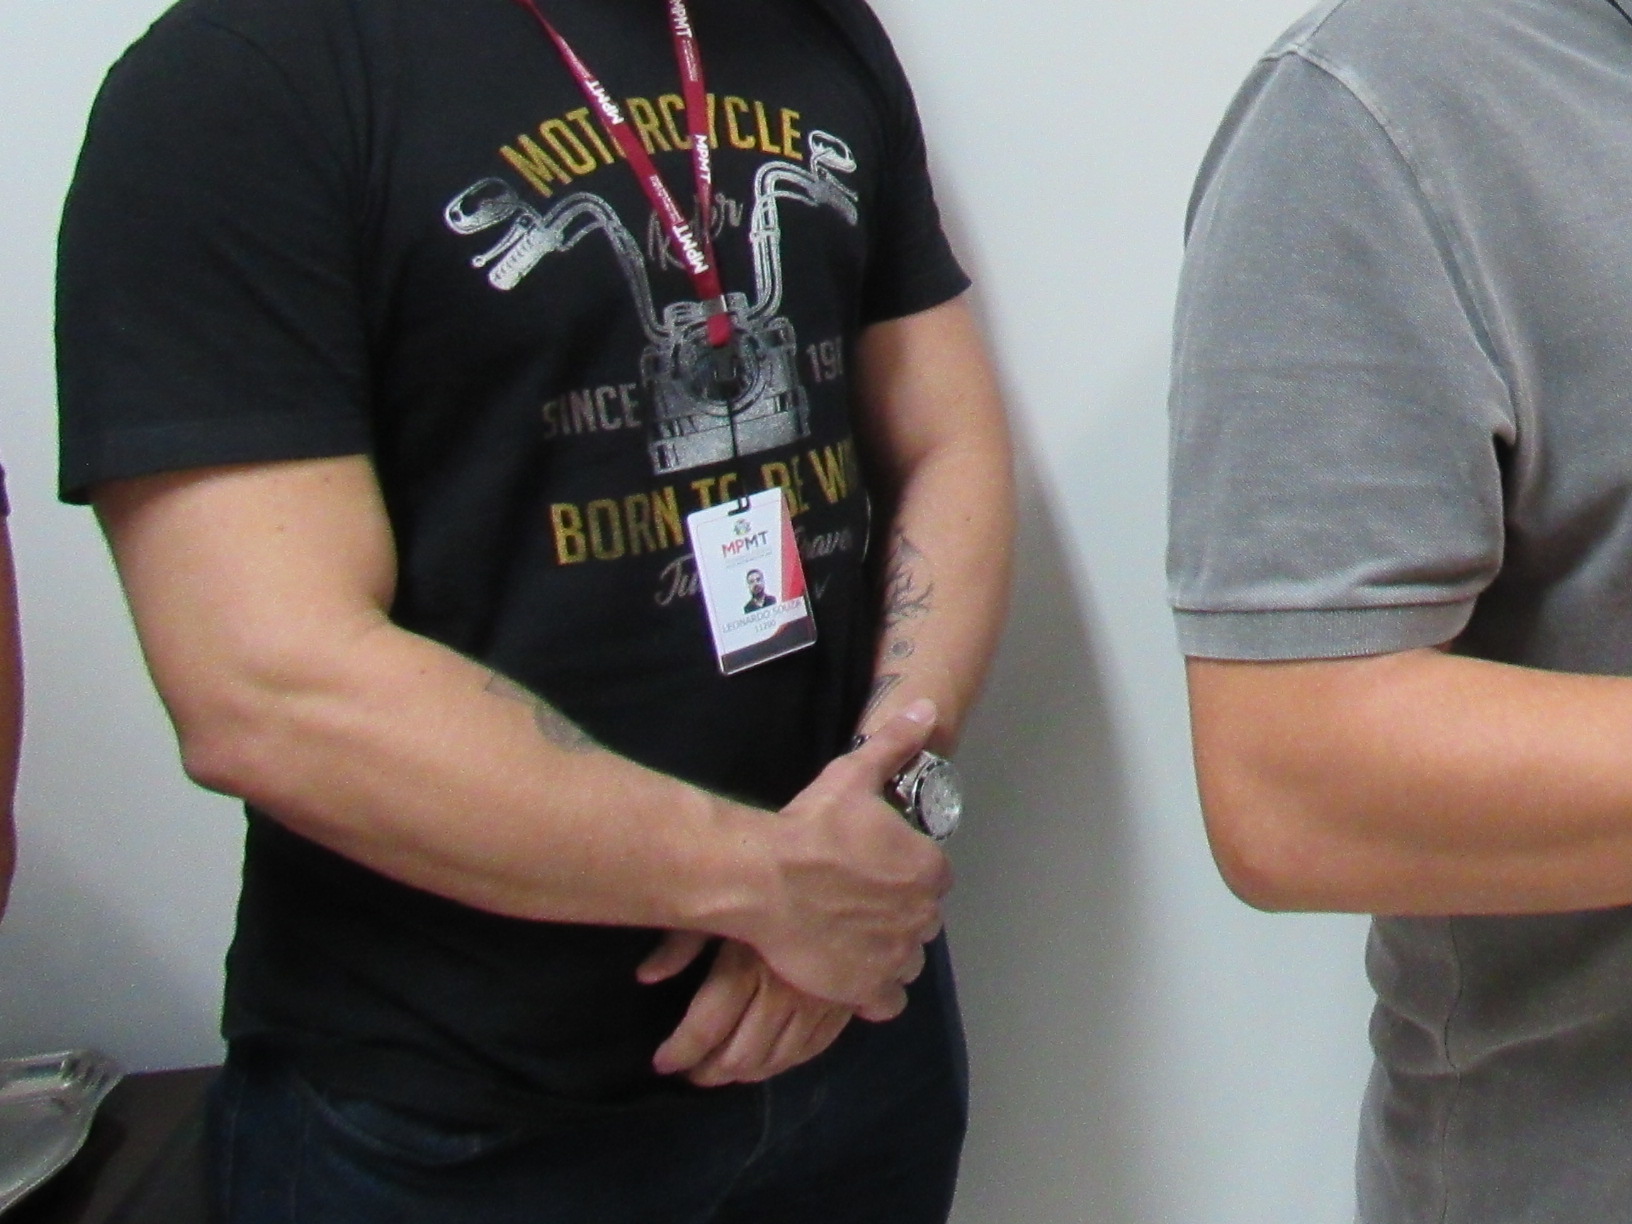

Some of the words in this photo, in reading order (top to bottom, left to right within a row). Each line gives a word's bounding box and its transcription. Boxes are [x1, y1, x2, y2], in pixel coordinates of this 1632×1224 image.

[585, 80, 625, 125] MPMT
[694, 134, 711, 184] MPMT
[672, 224, 709, 275] MPMT
[543, 383, 642, 438] SINCE
[550, 486, 684, 566] BORN
[721, 530, 769, 558] MPMT
